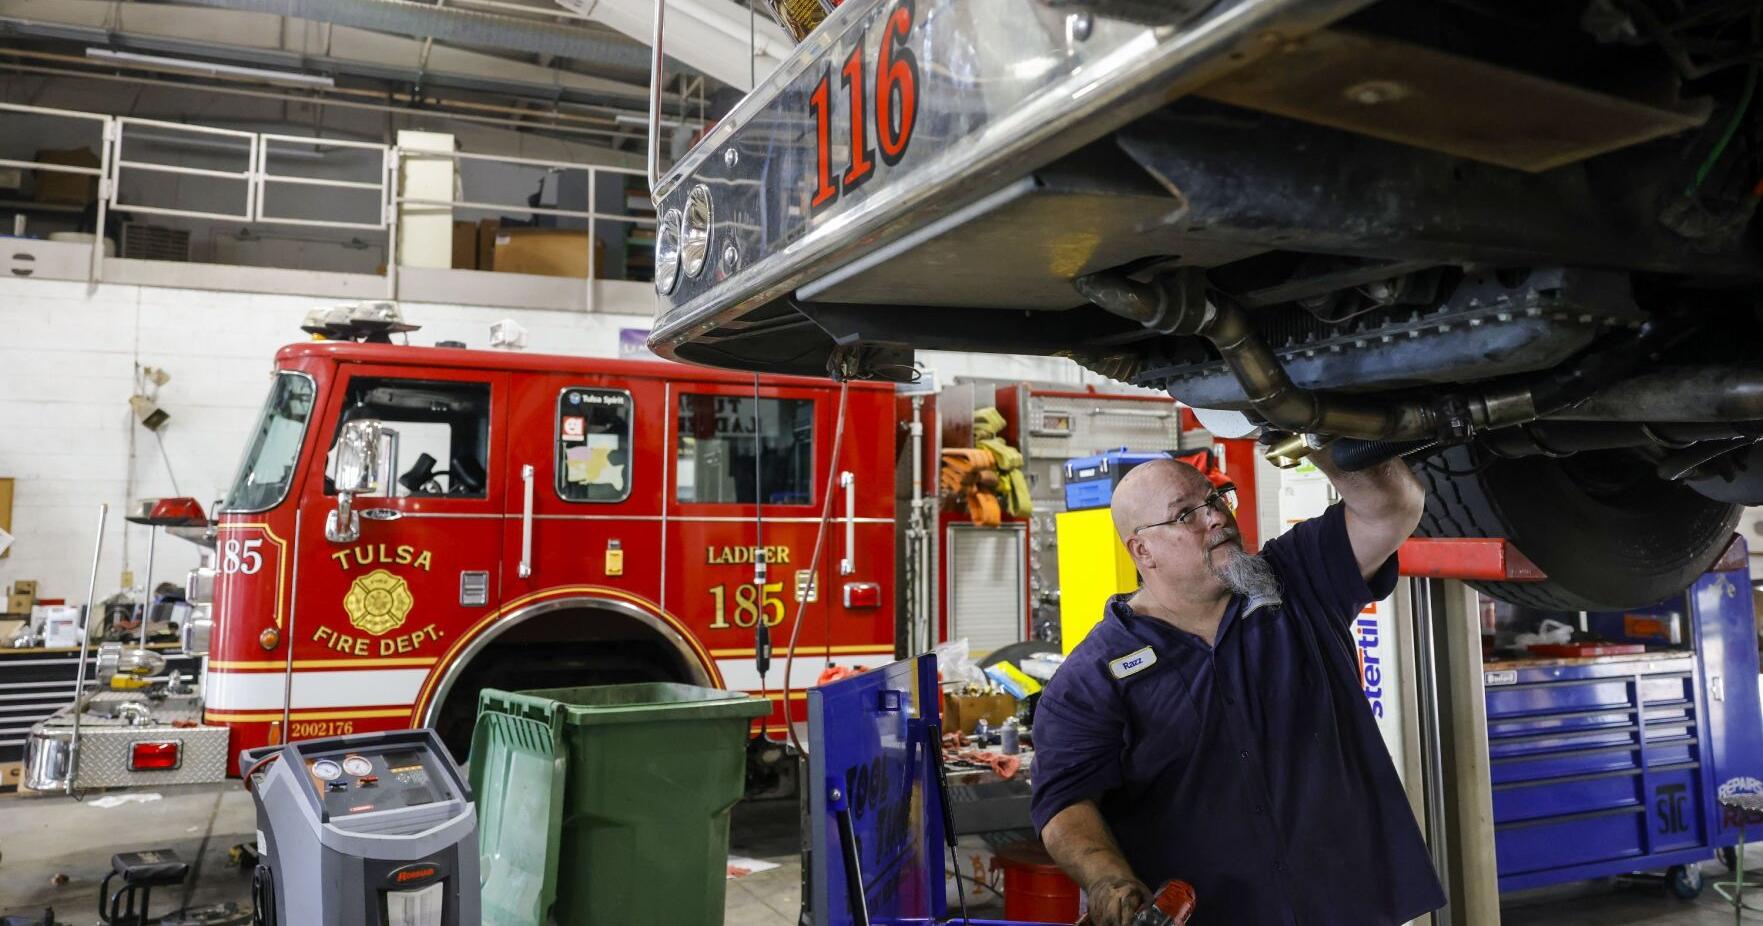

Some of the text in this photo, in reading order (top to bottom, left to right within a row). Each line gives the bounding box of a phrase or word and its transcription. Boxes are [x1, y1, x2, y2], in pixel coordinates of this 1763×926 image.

[808, 2, 919, 214] 116
[582, 394, 624, 405] Tulsa Spirit
[216, 538, 263, 575] 185
[331, 543, 432, 572] TULSA
[709, 582, 785, 629] 185
[312, 623, 445, 656] FIRE DEPT.
[1122, 657, 1144, 670] Razz
[1357, 619, 1384, 719] stertil
[291, 721, 353, 737] 2002176
